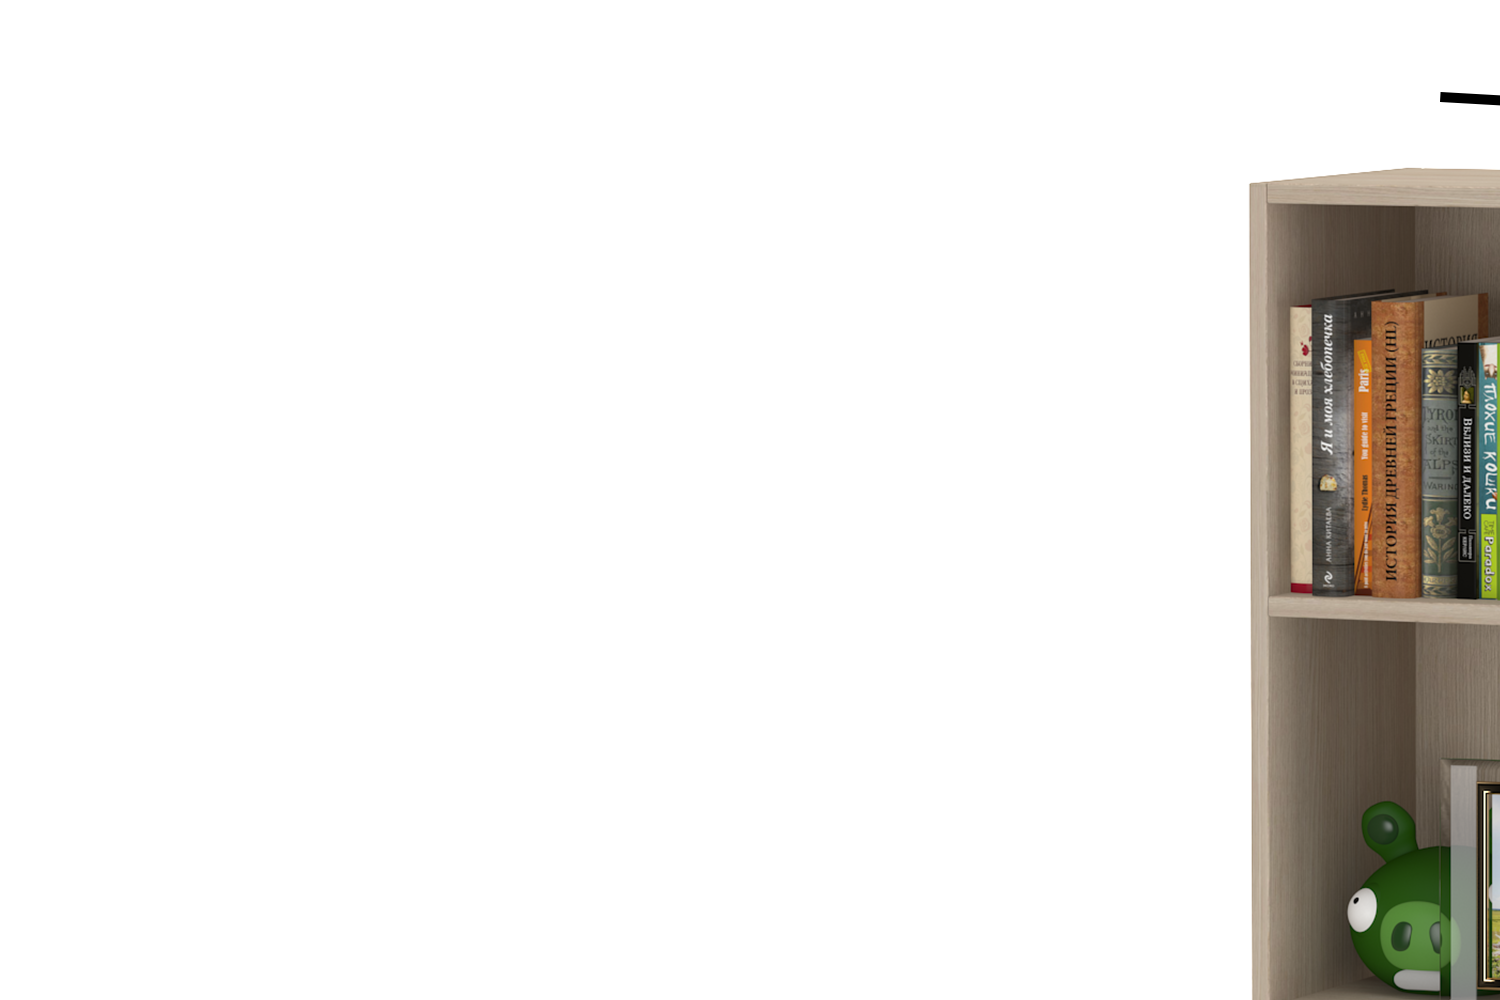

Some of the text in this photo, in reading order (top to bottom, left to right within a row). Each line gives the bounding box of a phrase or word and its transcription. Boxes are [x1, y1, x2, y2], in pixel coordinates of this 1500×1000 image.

[1320, 313, 1333, 455] Я и моя хлебопечка
[1358, 369, 1369, 393] Paris
[1361, 431, 1369, 448] guide
[1383, 321, 1399, 581] ИСТОРИЯ ДРЕВНЕЙ ГРЕЦИИ (HL)
[1462, 417, 1472, 520] ВБЛИЗИ И ДАЛЕКО
[1482, 382, 1497, 510] ПЛОХИЕ КОШКИ
[1361, 497, 1369, 511] Lydie
[1484, 536, 1495, 592] Paradox
